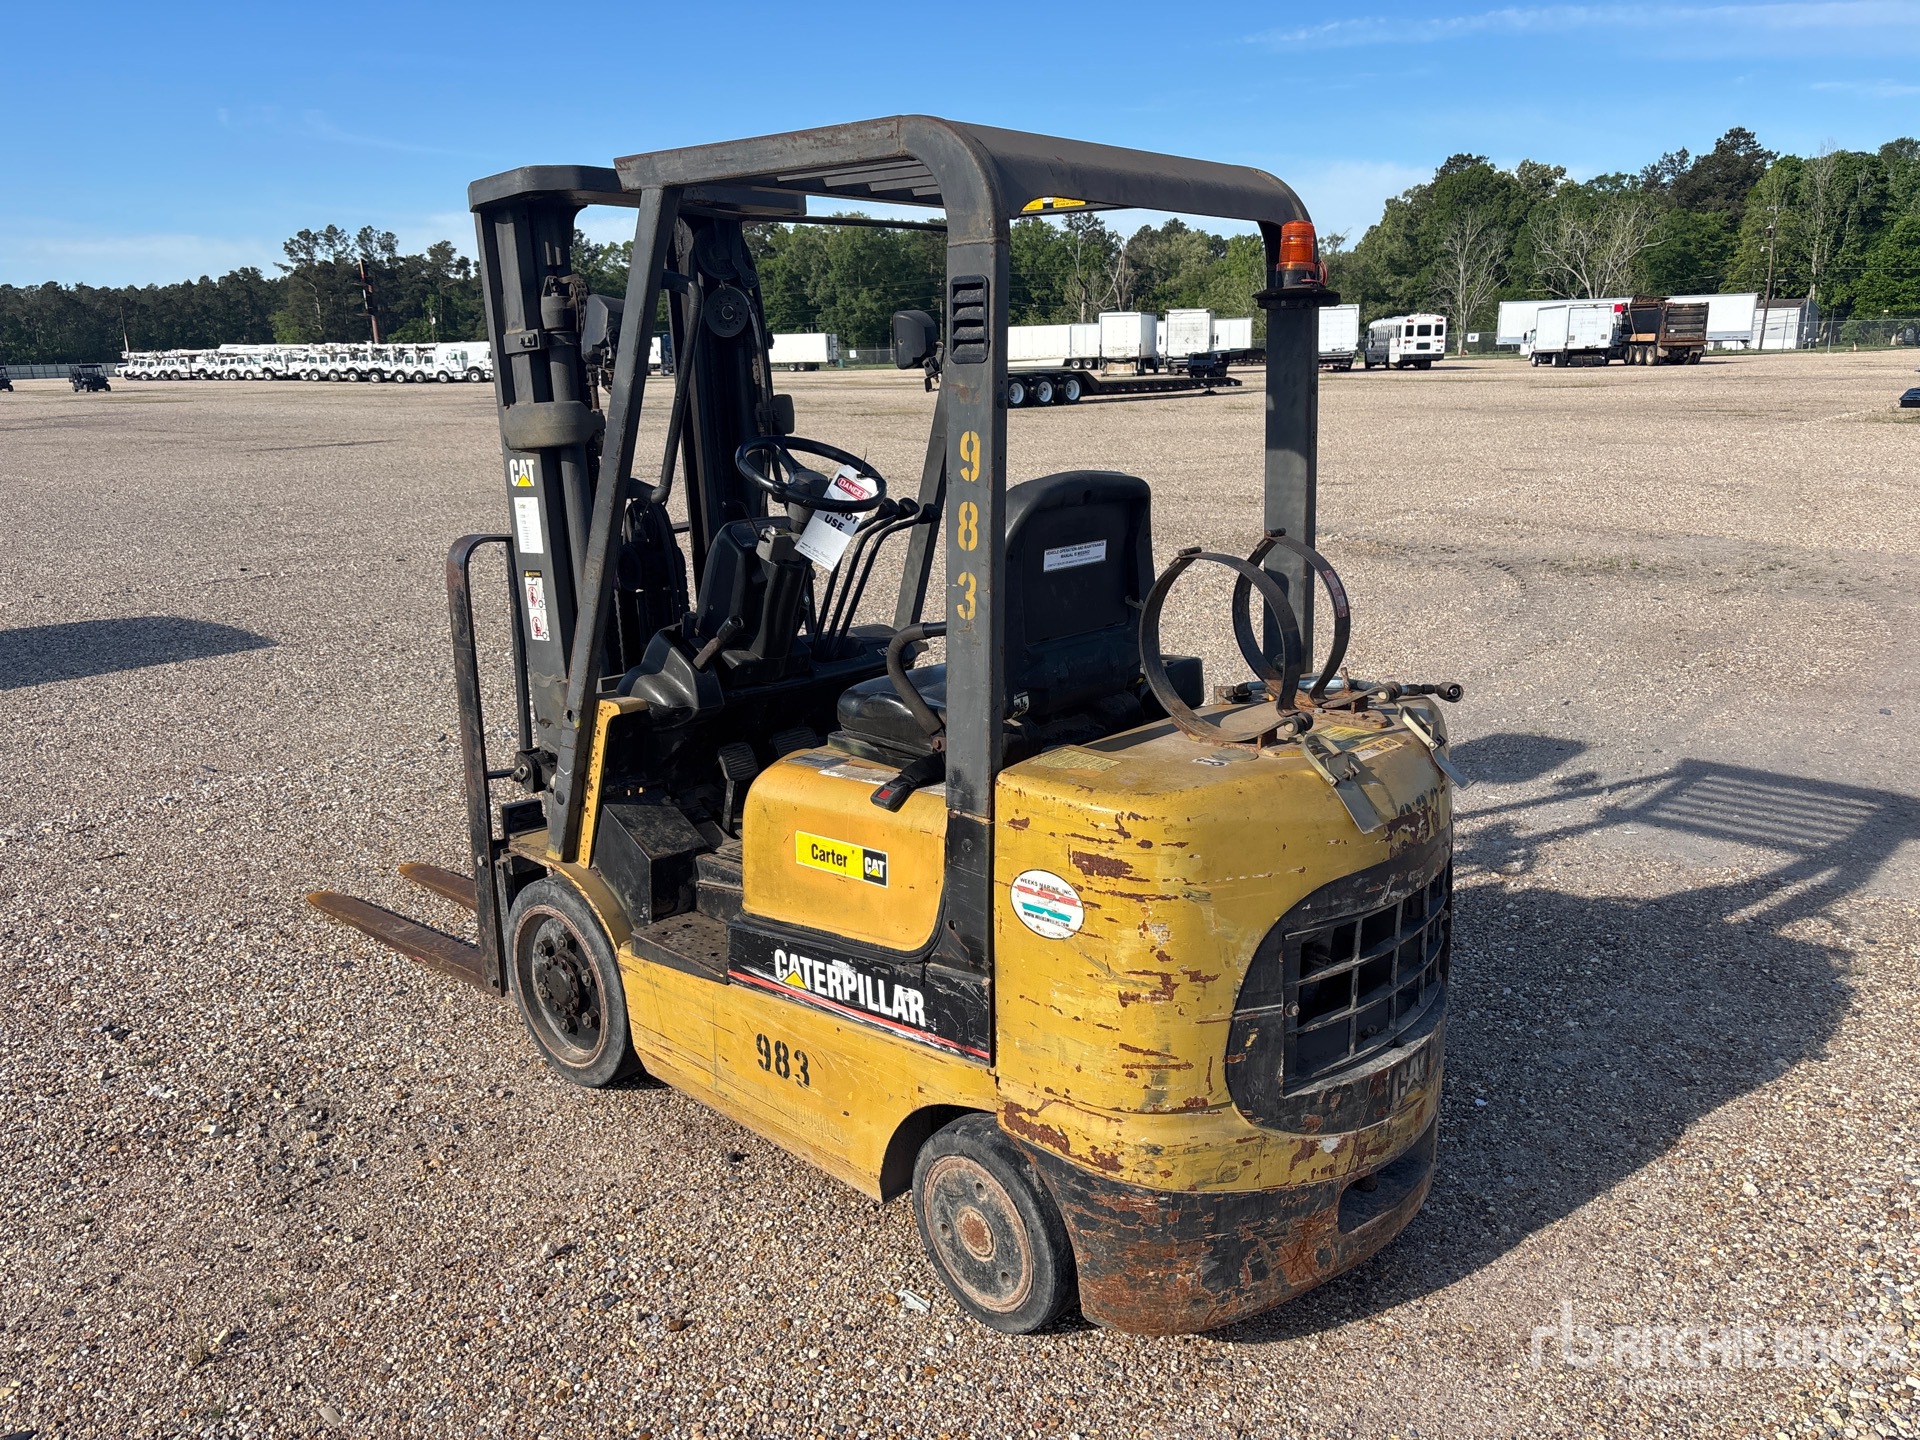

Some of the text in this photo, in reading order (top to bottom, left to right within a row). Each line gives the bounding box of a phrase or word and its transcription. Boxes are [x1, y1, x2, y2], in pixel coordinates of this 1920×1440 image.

[508, 459, 535, 487] CAT
[824, 514, 845, 531] USE
[811, 843, 848, 868] Carter
[864, 856, 886, 878] CAT
[1020, 878, 1038, 887] WEEKS
[774, 949, 927, 1027] CATERPILLAR
[756, 1033, 810, 1088] 983
